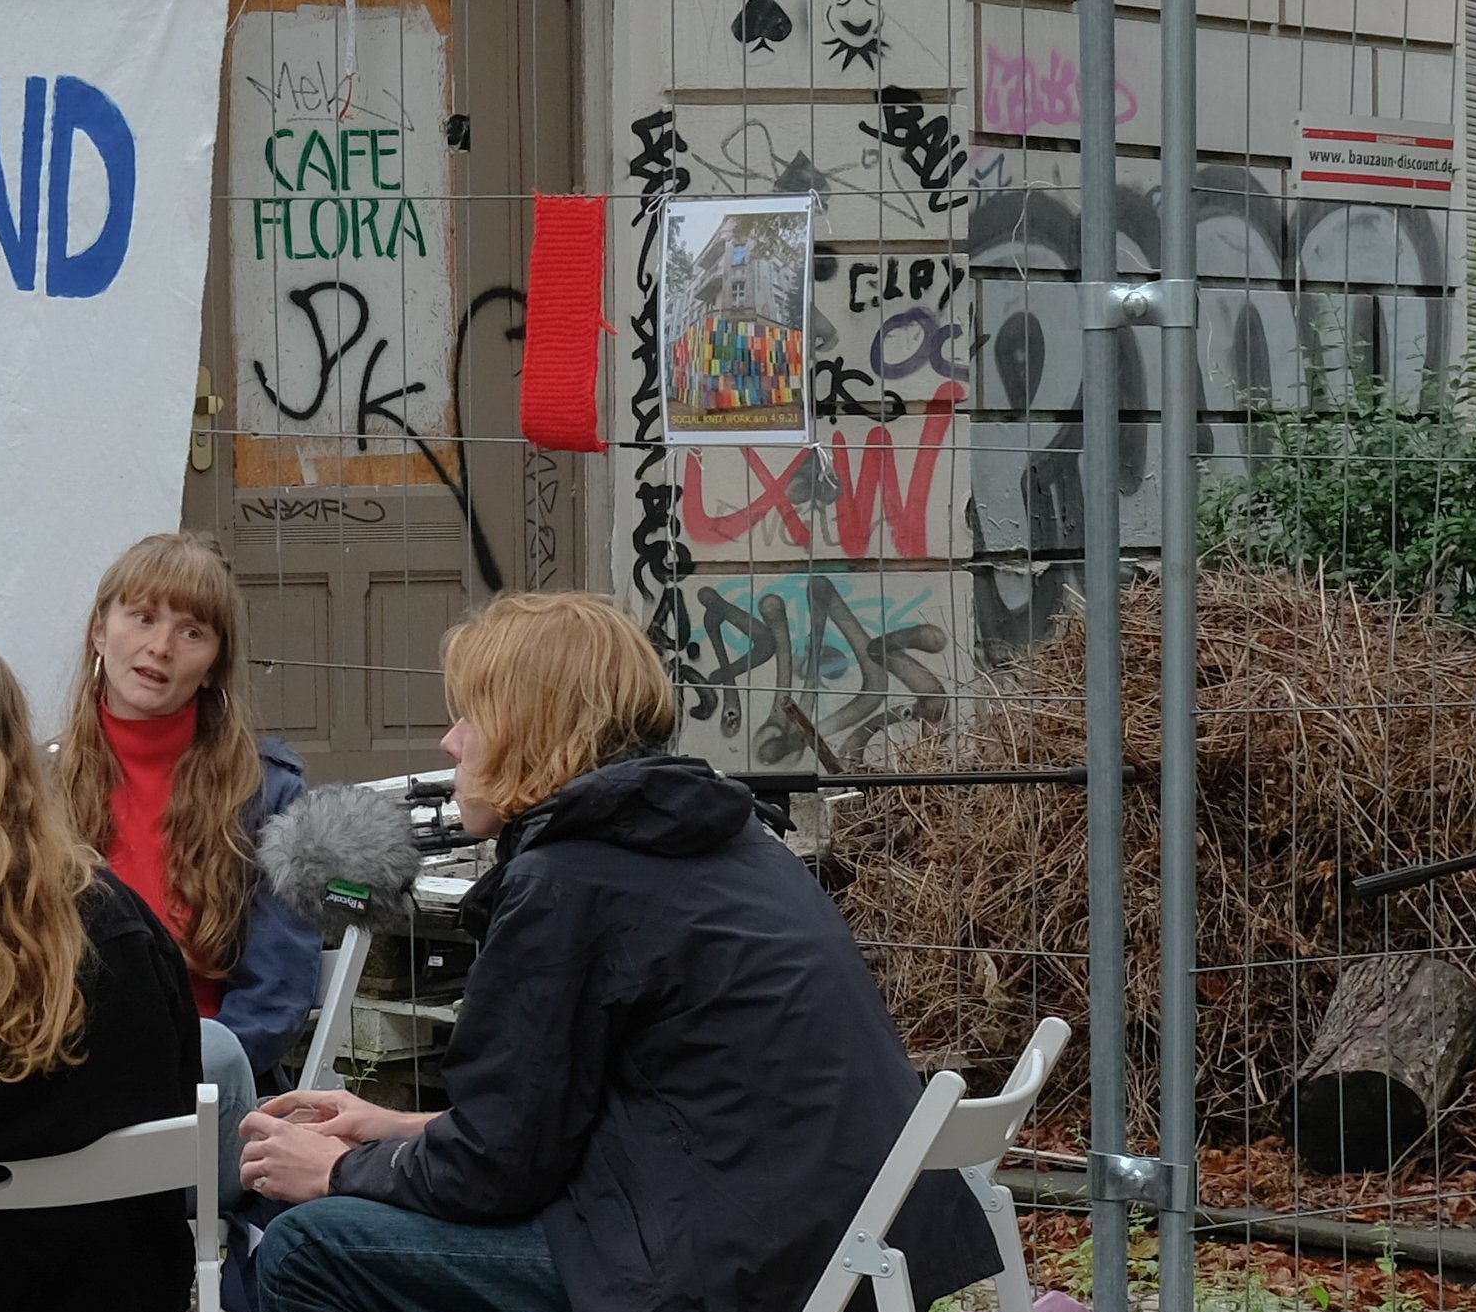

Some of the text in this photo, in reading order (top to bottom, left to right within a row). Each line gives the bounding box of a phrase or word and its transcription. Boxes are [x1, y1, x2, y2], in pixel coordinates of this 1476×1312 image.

[265, 129, 400, 192] CAFE
[252, 197, 427, 261] FLORA
[671, 414, 702, 425] SOCIAL
[725, 413, 751, 424] WORK
[752, 415, 768, 424] am
[770, 413, 799, 423] 4.9.21
